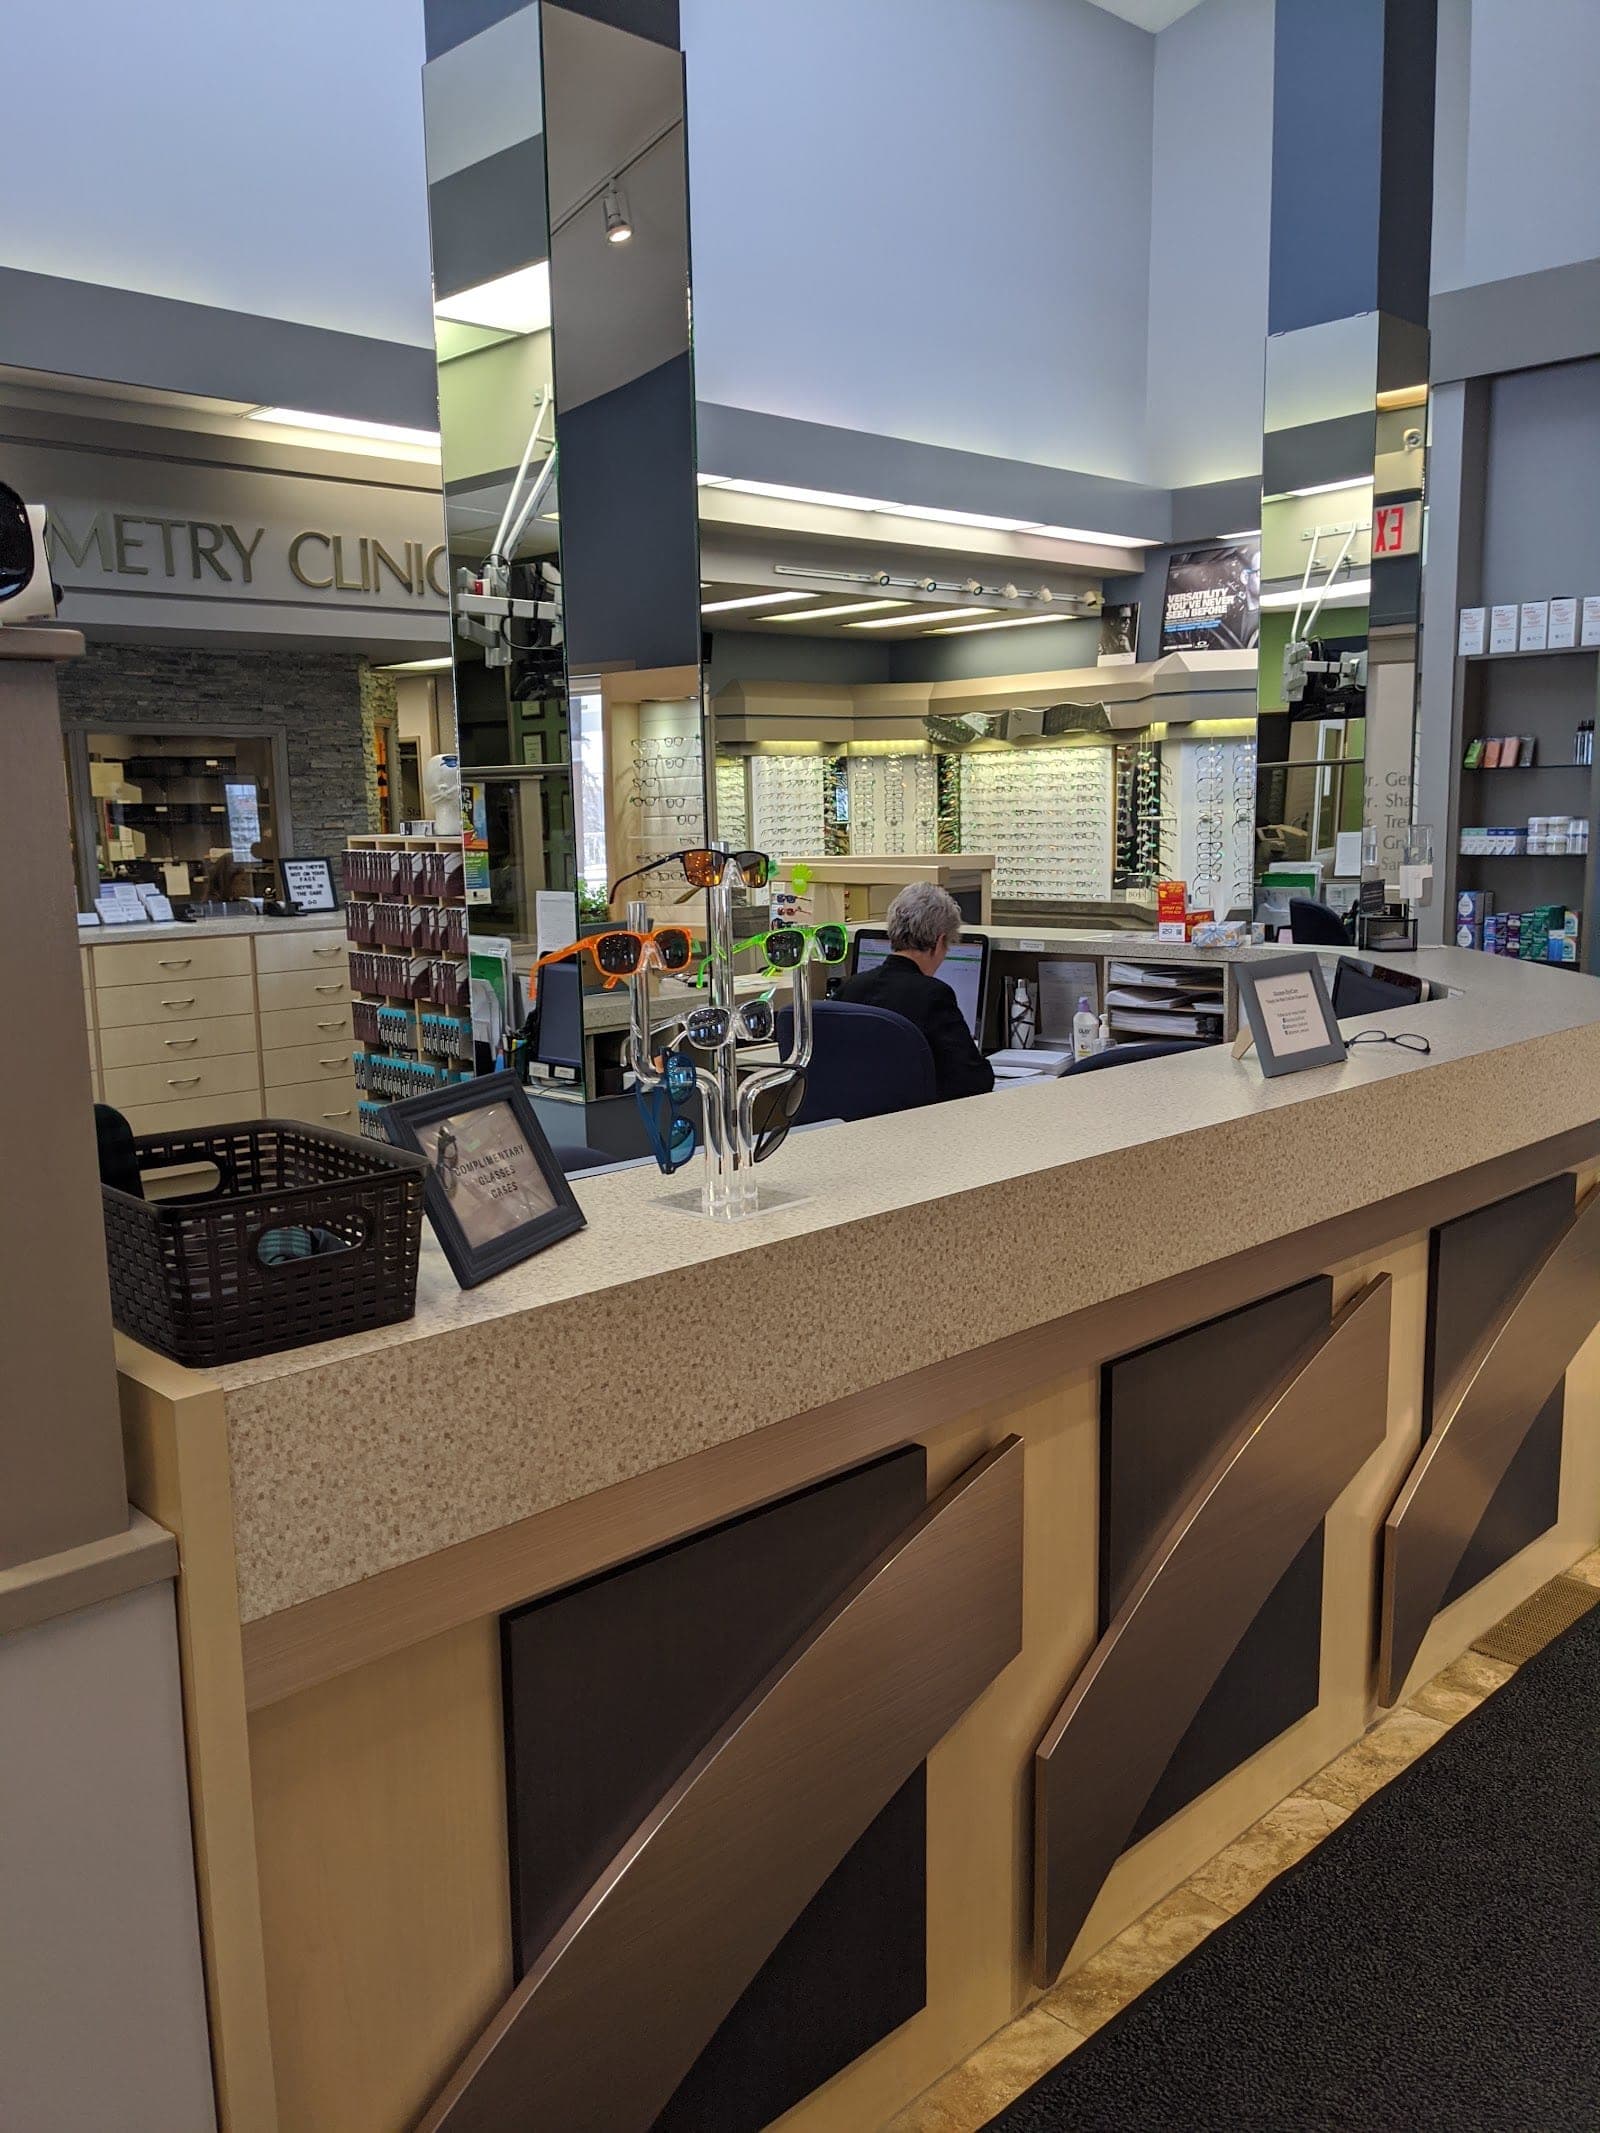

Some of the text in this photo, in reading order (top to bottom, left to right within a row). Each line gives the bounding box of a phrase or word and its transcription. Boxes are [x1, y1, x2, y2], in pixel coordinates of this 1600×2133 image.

[1166, 595, 1236, 612] YOU'VE NEVER
[1167, 587, 1229, 603] VERSATILITY
[1165, 604, 1228, 620] SEEN BEFORE
[454, 1144, 525, 1177] COMPLIMENTARY
[478, 1165, 517, 1186] GLASSES
[490, 1181, 518, 1199] CASES
